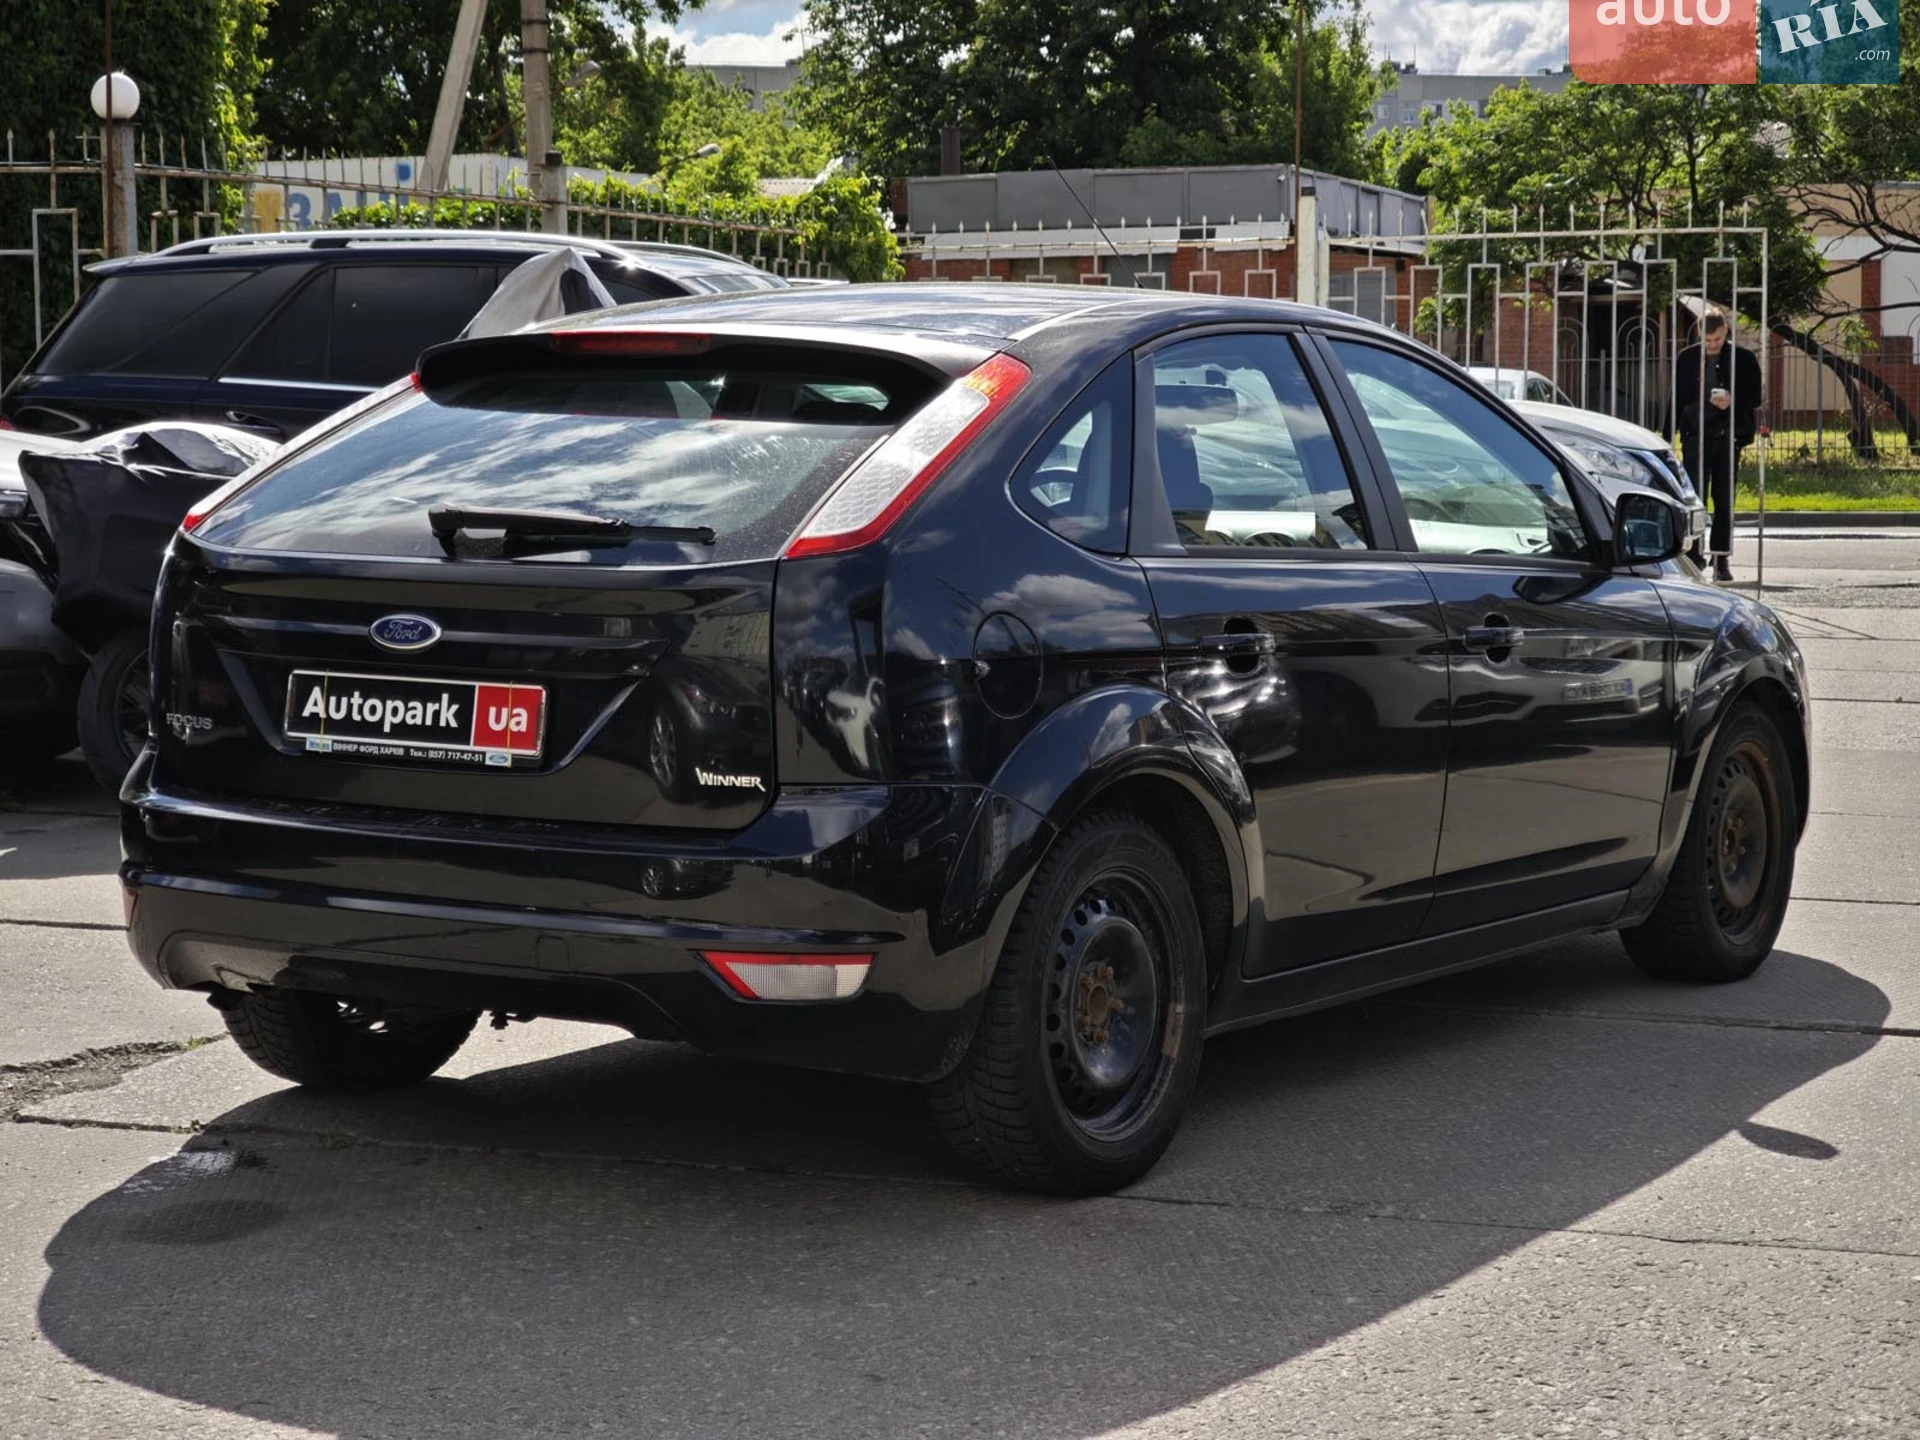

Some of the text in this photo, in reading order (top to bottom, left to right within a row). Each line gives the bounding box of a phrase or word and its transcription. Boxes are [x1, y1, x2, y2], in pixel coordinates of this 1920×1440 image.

[383, 619, 423, 640] Ford
[165, 712, 213, 730] FOCUS
[302, 686, 528, 733] Autopark ua
[695, 767, 767, 792] WINNER
